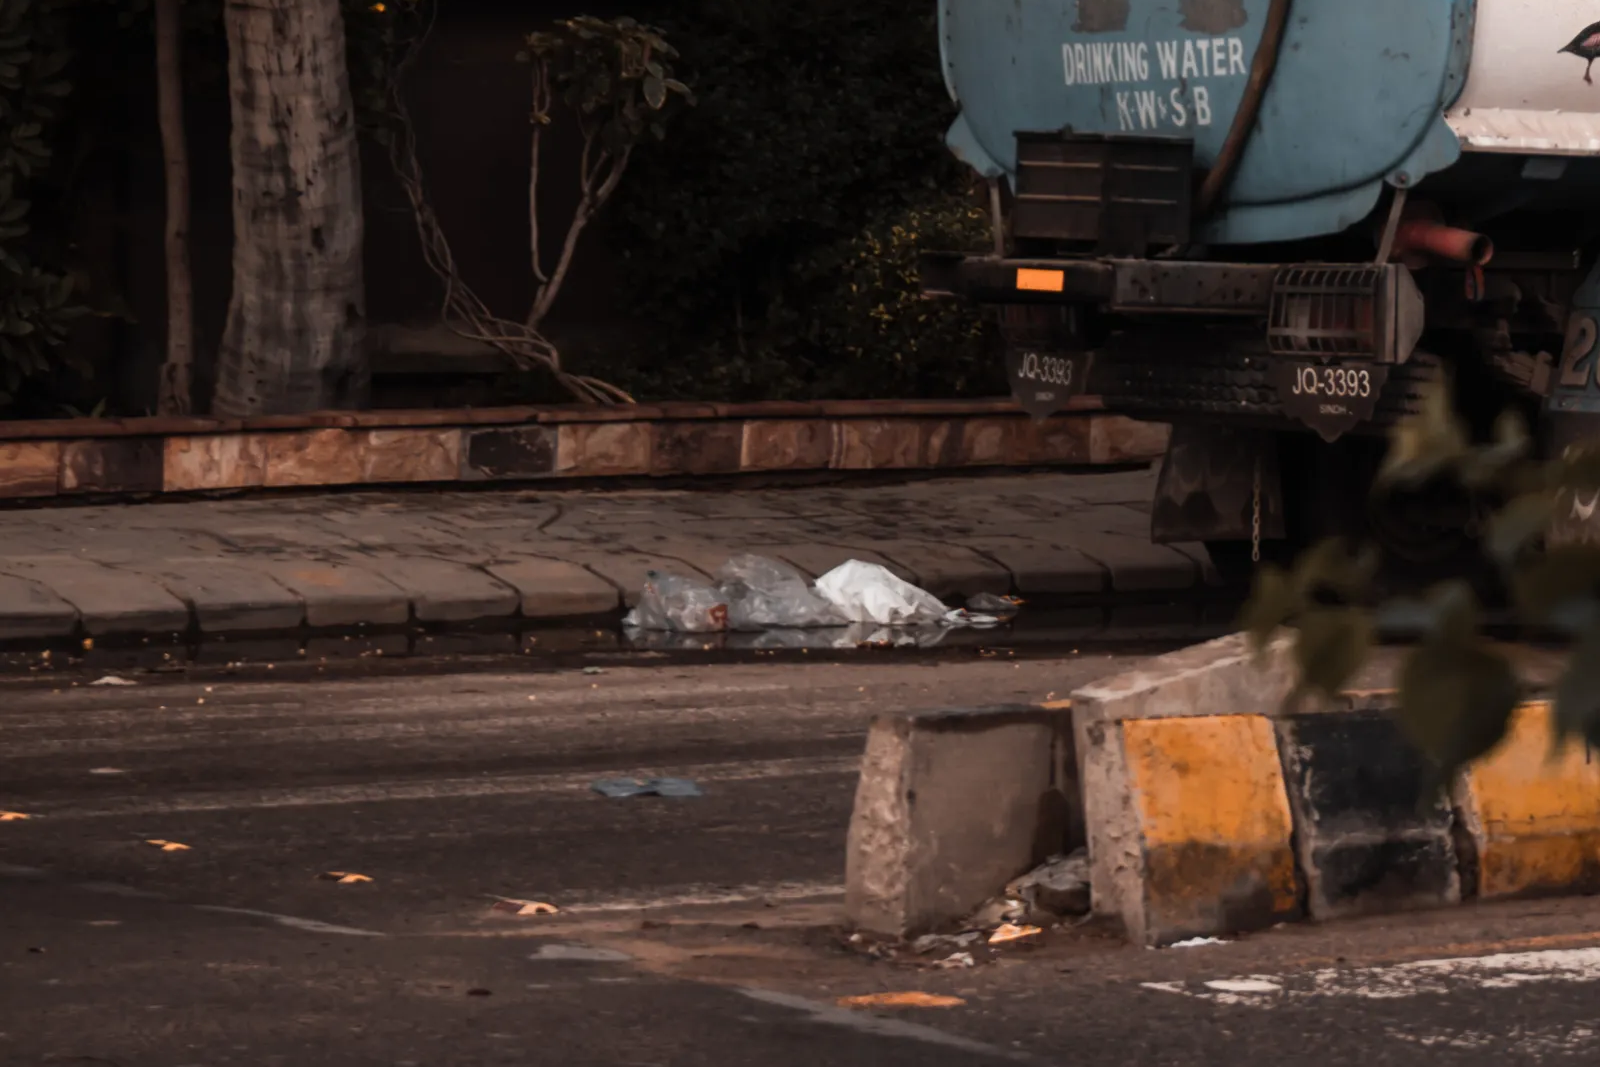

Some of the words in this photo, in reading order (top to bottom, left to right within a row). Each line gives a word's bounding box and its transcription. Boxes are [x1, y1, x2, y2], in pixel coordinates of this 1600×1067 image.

[1062, 41, 1149, 85] DRINKING
[1156, 37, 1247, 80] WATER
[1018, 352, 1073, 386] JQ-3393
[1292, 367, 1371, 397] JQ-3393
